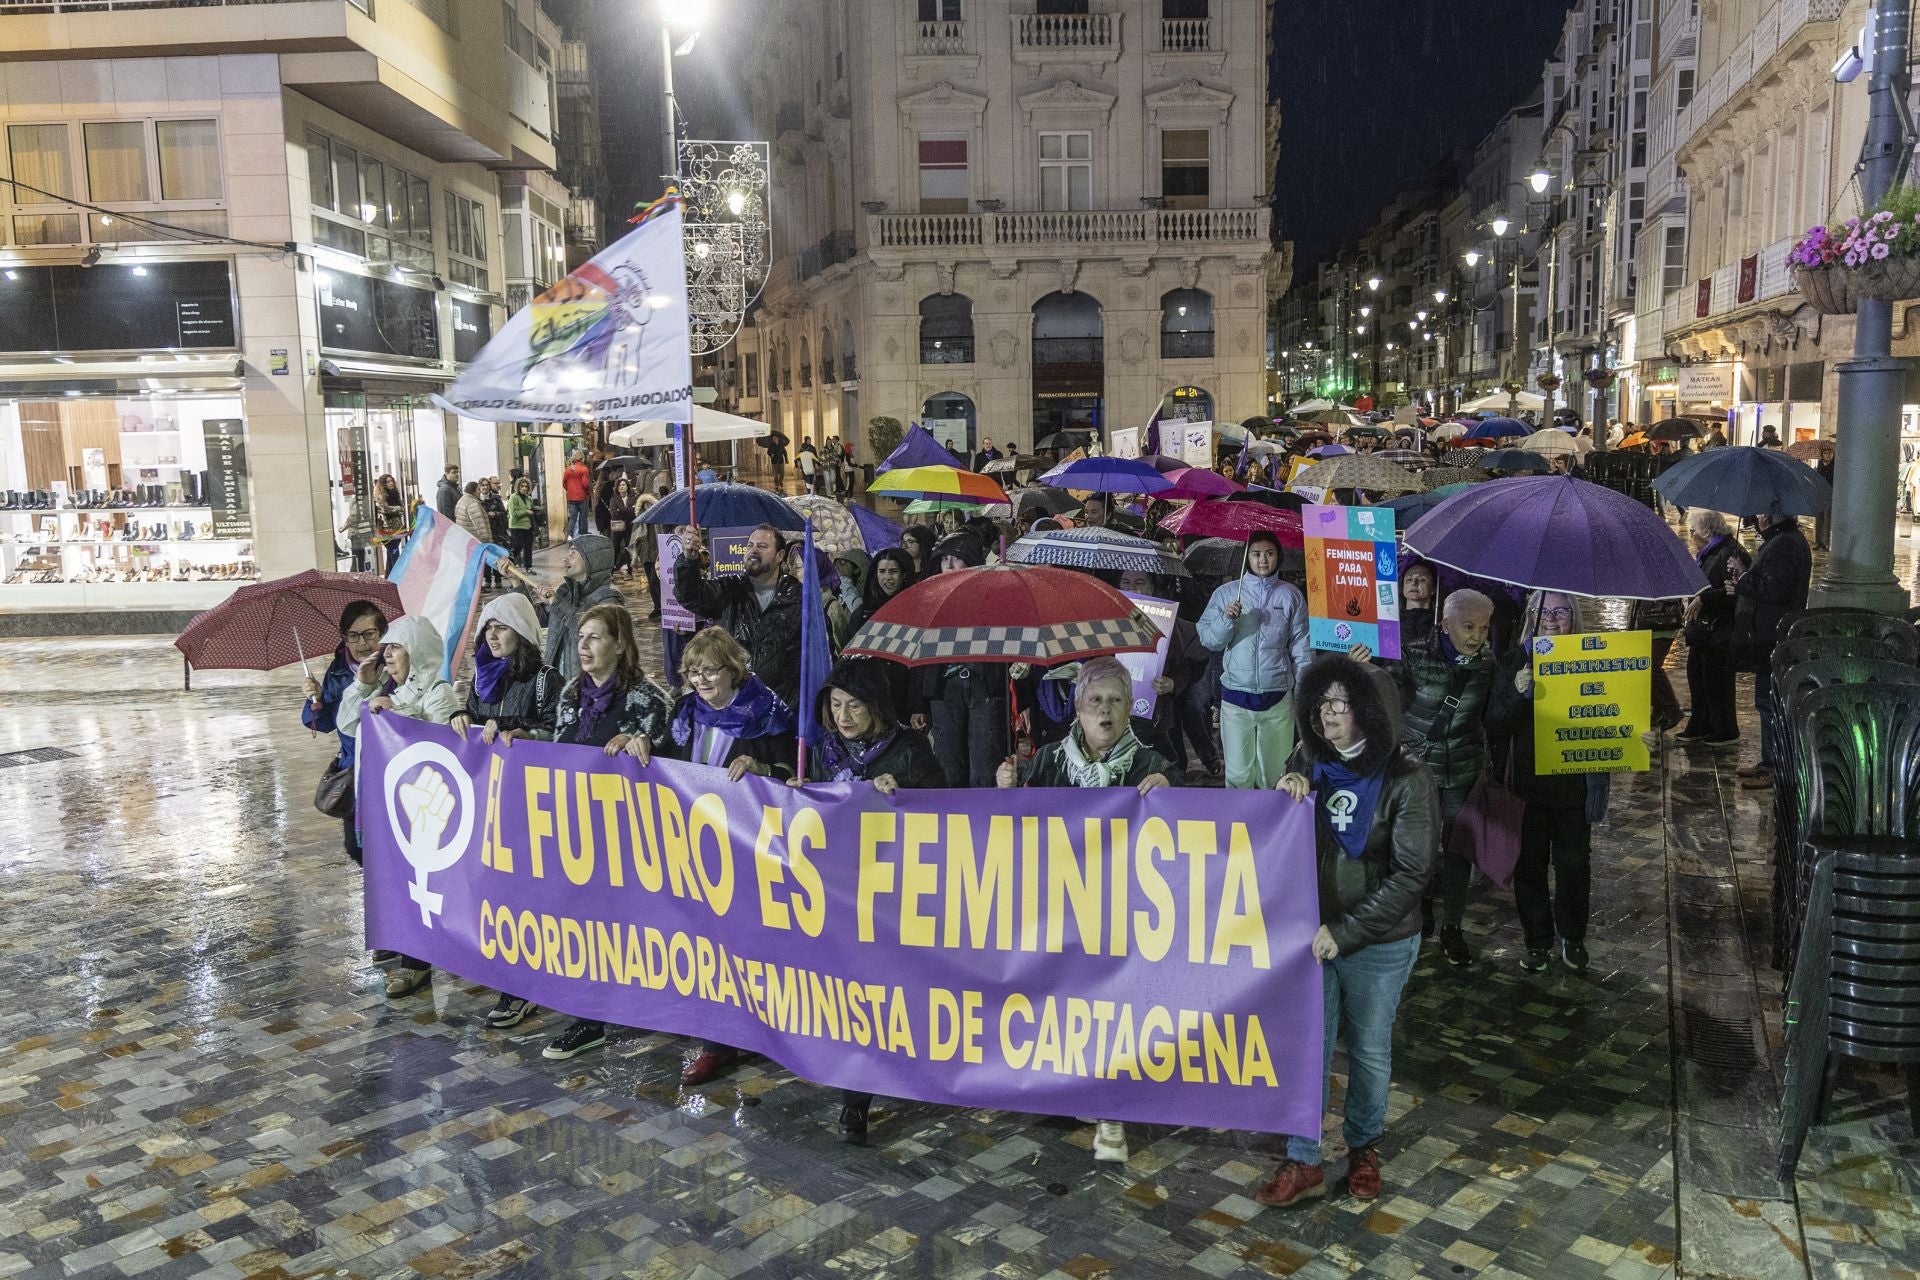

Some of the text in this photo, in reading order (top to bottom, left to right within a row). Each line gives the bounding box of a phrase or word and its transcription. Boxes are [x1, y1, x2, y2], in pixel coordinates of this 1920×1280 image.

[219, 422, 237, 521] FINAL DE TEMPORADA
[215, 521, 251, 529] ULTIMOS
[1326, 548, 1374, 562] FEMINISMO
[1338, 562, 1362, 574] PARA
[1335, 575, 1369, 588] LA VIDA
[1322, 641, 1341, 649] FUTURO
[1581, 636, 1608, 651] EL
[1539, 656, 1651, 676] FEMINISMO
[1580, 681, 1607, 696] ES
[1568, 703, 1620, 719] PARA
[1555, 724, 1634, 742] TODAS Y
[1561, 747, 1624, 763] TODOS
[1597, 764, 1632, 772] FEMINISTA
[480, 753, 1271, 969] EL FUTURO ES FEMINISTA
[479, 899, 1279, 1087] COORDINADORA FEMINISTA DE CARTAGENA
